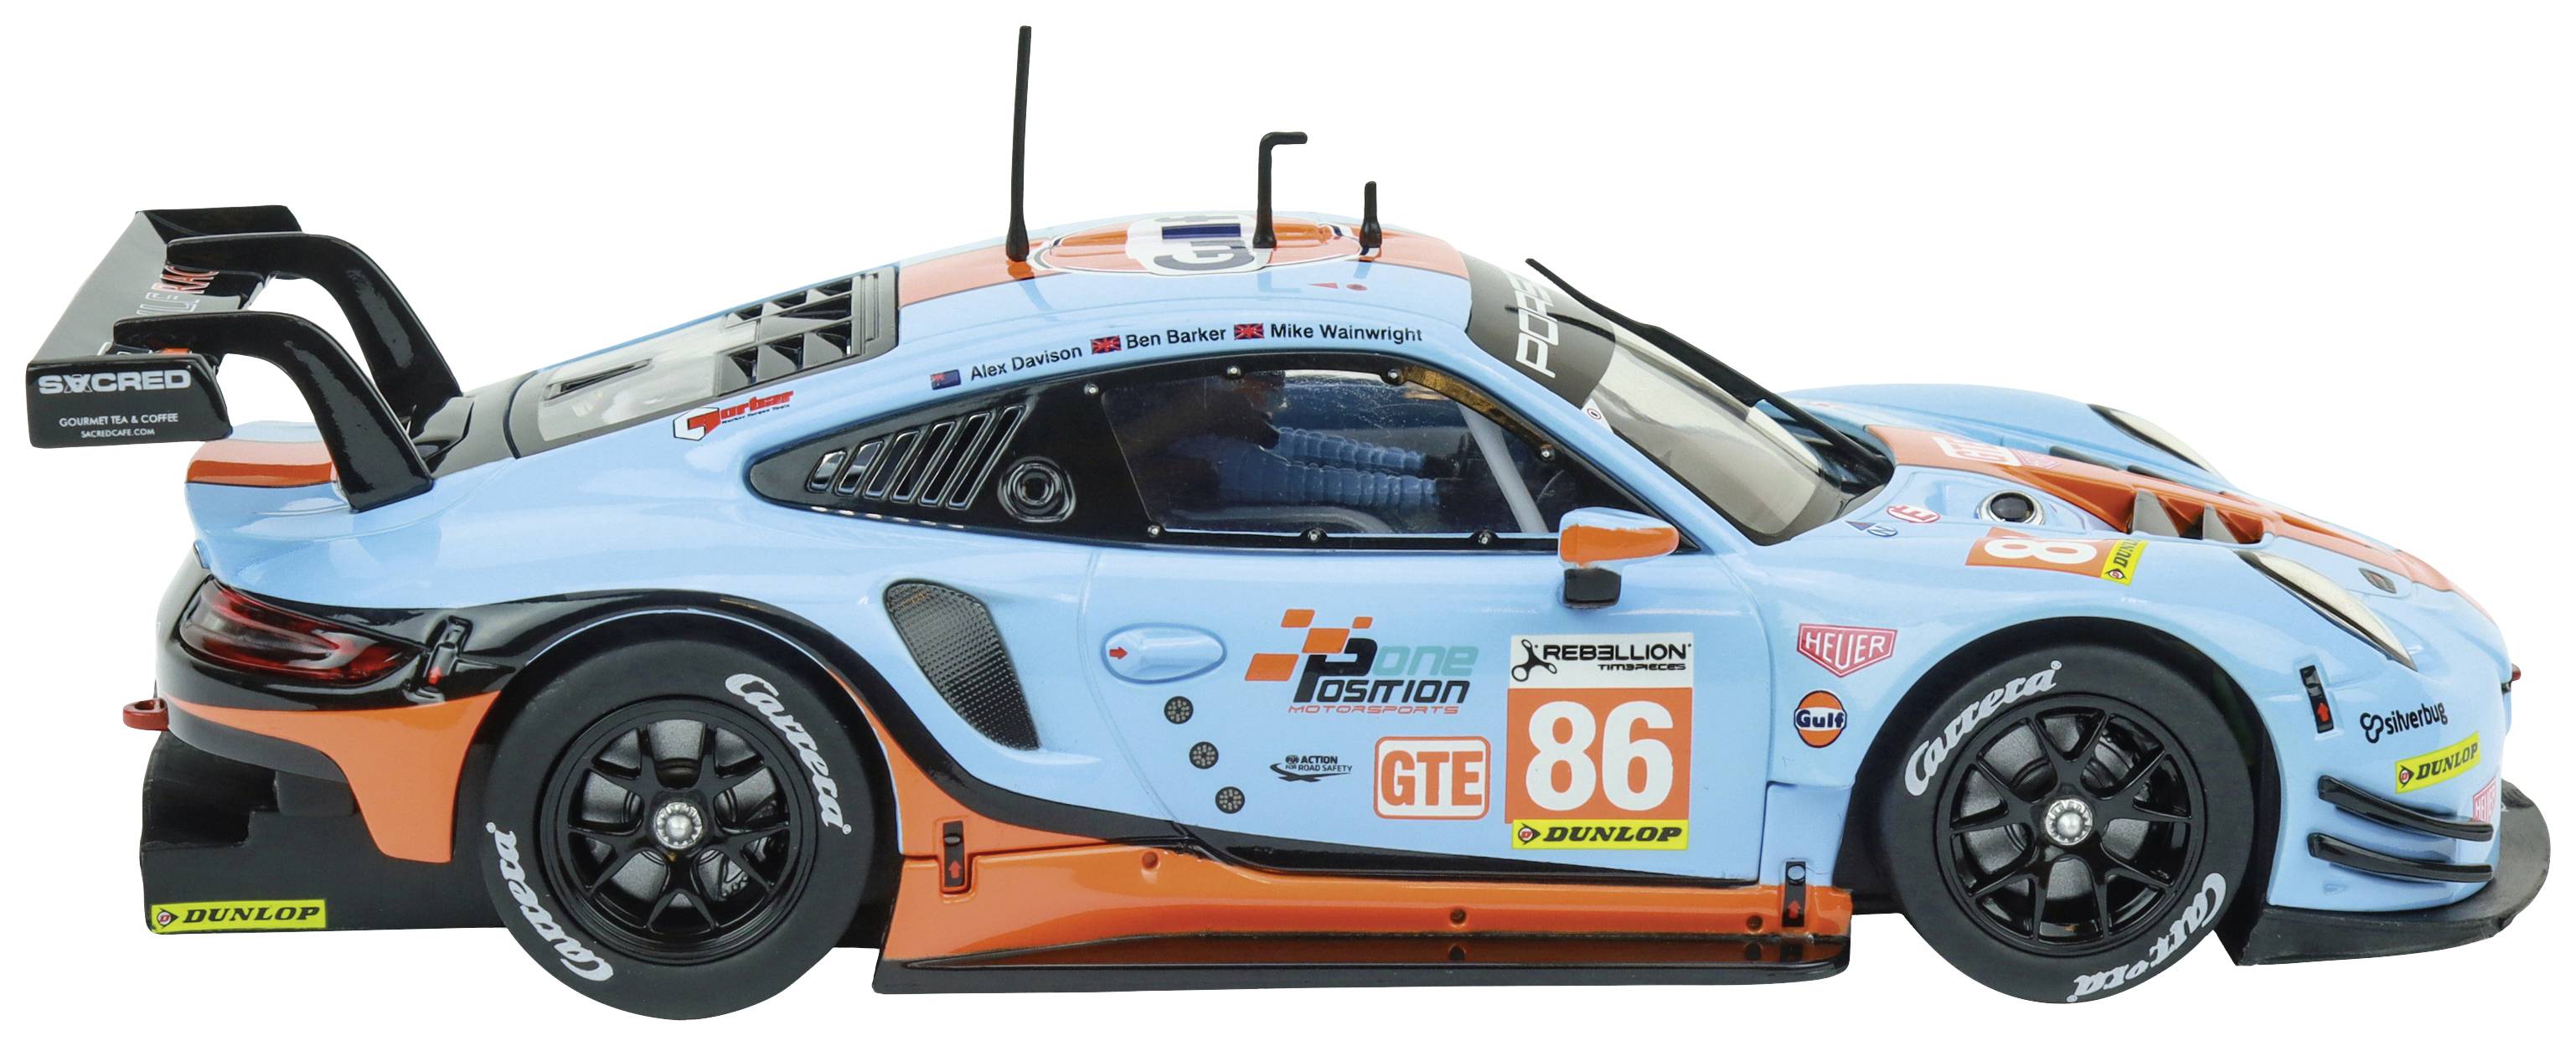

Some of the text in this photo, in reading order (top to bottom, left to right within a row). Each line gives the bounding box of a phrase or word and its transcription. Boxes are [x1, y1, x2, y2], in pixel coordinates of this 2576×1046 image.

[1126, 327, 1227, 349] Ben Barker
[1270, 322, 1422, 345] Mike Wainwright
[1506, 272, 1559, 379] PORS
[970, 344, 1083, 381] Alex Davison
[59, 413, 179, 427] GOURMET TEA & COFFEE
[80, 428, 156, 439] SACREDCAFE.COM
[1984, 536, 2098, 564] 8
[1542, 644, 1687, 661] REBELLION
[1804, 631, 1886, 670] HEUER
[1288, 705, 1459, 714] MOTORSPORTS
[1796, 709, 1845, 728] Gulf
[2384, 702, 2449, 734] silverbug
[1904, 669, 2057, 796] Carrera
[725, 672, 844, 828] Carrera
[1300, 755, 1339, 764] ACTION
[1525, 700, 1675, 812] 86
[2416, 742, 2478, 781] DUNLOP
[1381, 750, 1483, 806] GTE
[1542, 827, 1682, 842] DUNLOP
[183, 906, 320, 923] DUNLOP
[494, 829, 614, 982] Carrera
